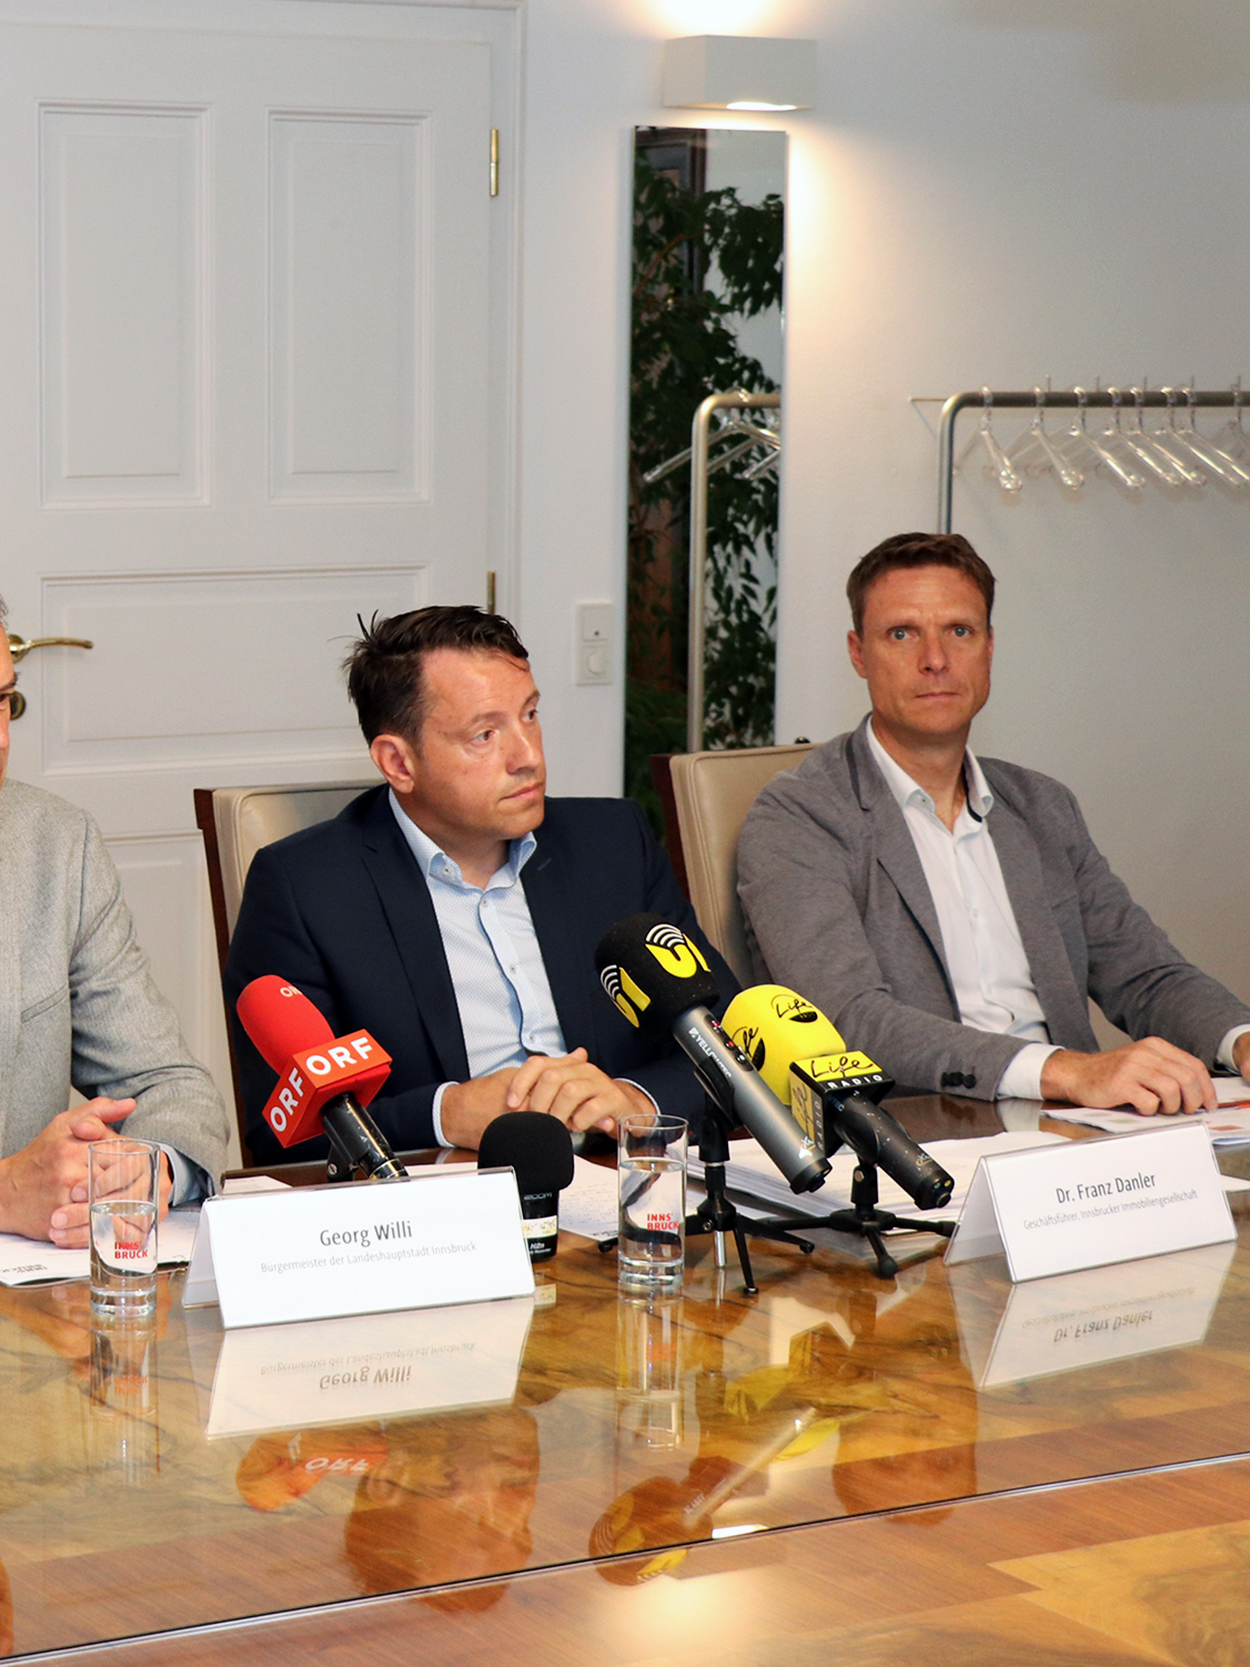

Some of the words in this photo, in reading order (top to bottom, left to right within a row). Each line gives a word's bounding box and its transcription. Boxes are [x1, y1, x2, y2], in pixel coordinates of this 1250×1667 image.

[280, 985, 303, 997] OR
[306, 1037, 373, 1075] ORF
[811, 1056, 873, 1078] Life
[827, 1074, 883, 1089] RADIO
[270, 1067, 304, 1132] ORF
[1056, 1187, 1075, 1203] Dr.
[1077, 1182, 1113, 1199] Franz
[1115, 1172, 1156, 1193] Danler
[1080, 1203, 1121, 1219] Innsbrucker
[1121, 1188, 1198, 1212] Immobiliengesellschaft
[320, 1229, 371, 1248] Georg
[374, 1220, 413, 1241] Willi
[647, 1221, 680, 1231] BRUCK
[114, 1249, 148, 1259] BRUCK
[260, 1257, 327, 1275] Bürgermeister
[329, 1253, 345, 1266] der
[347, 1246, 430, 1265] Landeshauptstadt
[431, 1241, 477, 1255] Innsbruck
